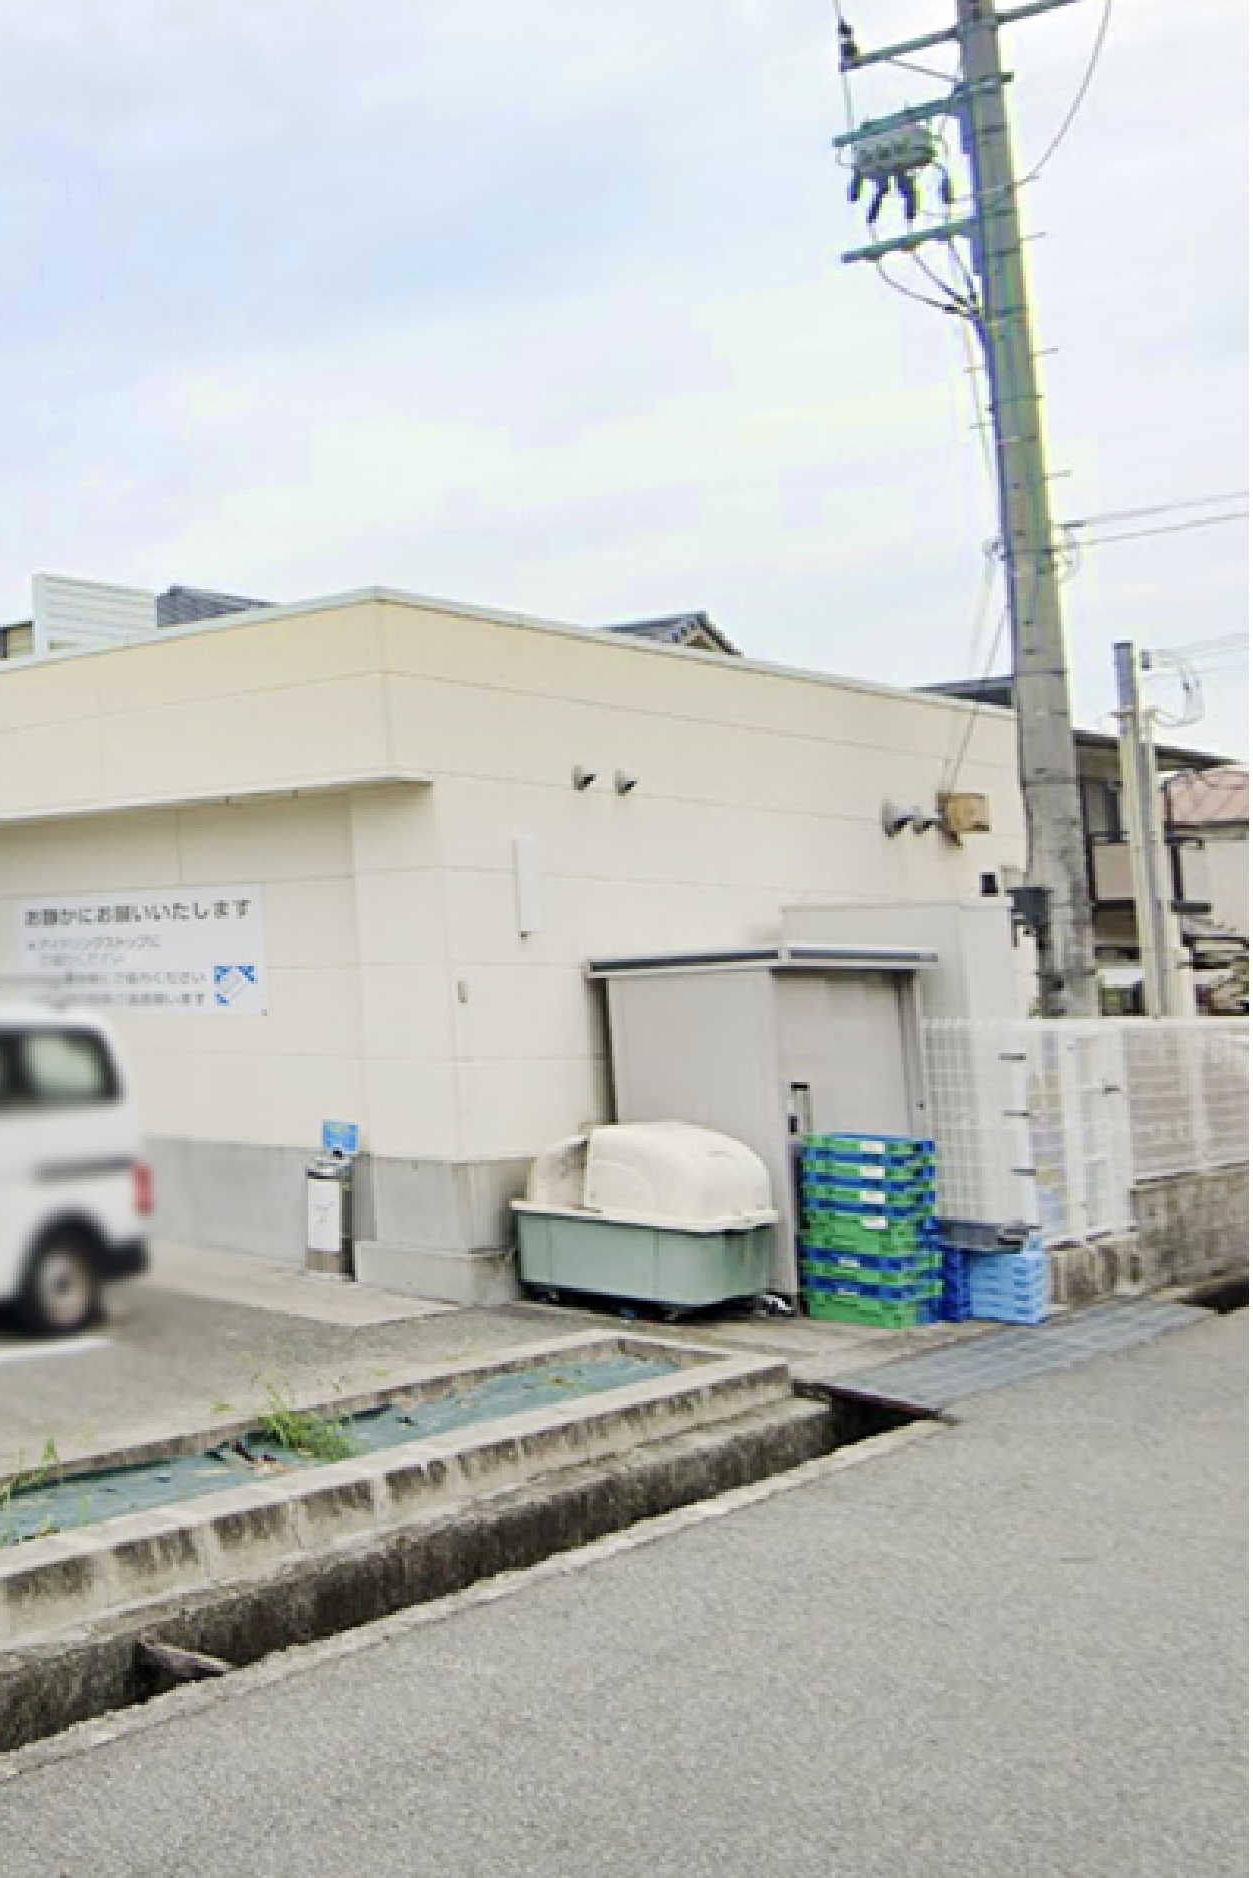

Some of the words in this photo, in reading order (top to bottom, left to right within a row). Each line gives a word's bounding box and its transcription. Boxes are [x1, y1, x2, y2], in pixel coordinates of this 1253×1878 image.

[24, 898, 252, 928] お静かにお願いいたします
